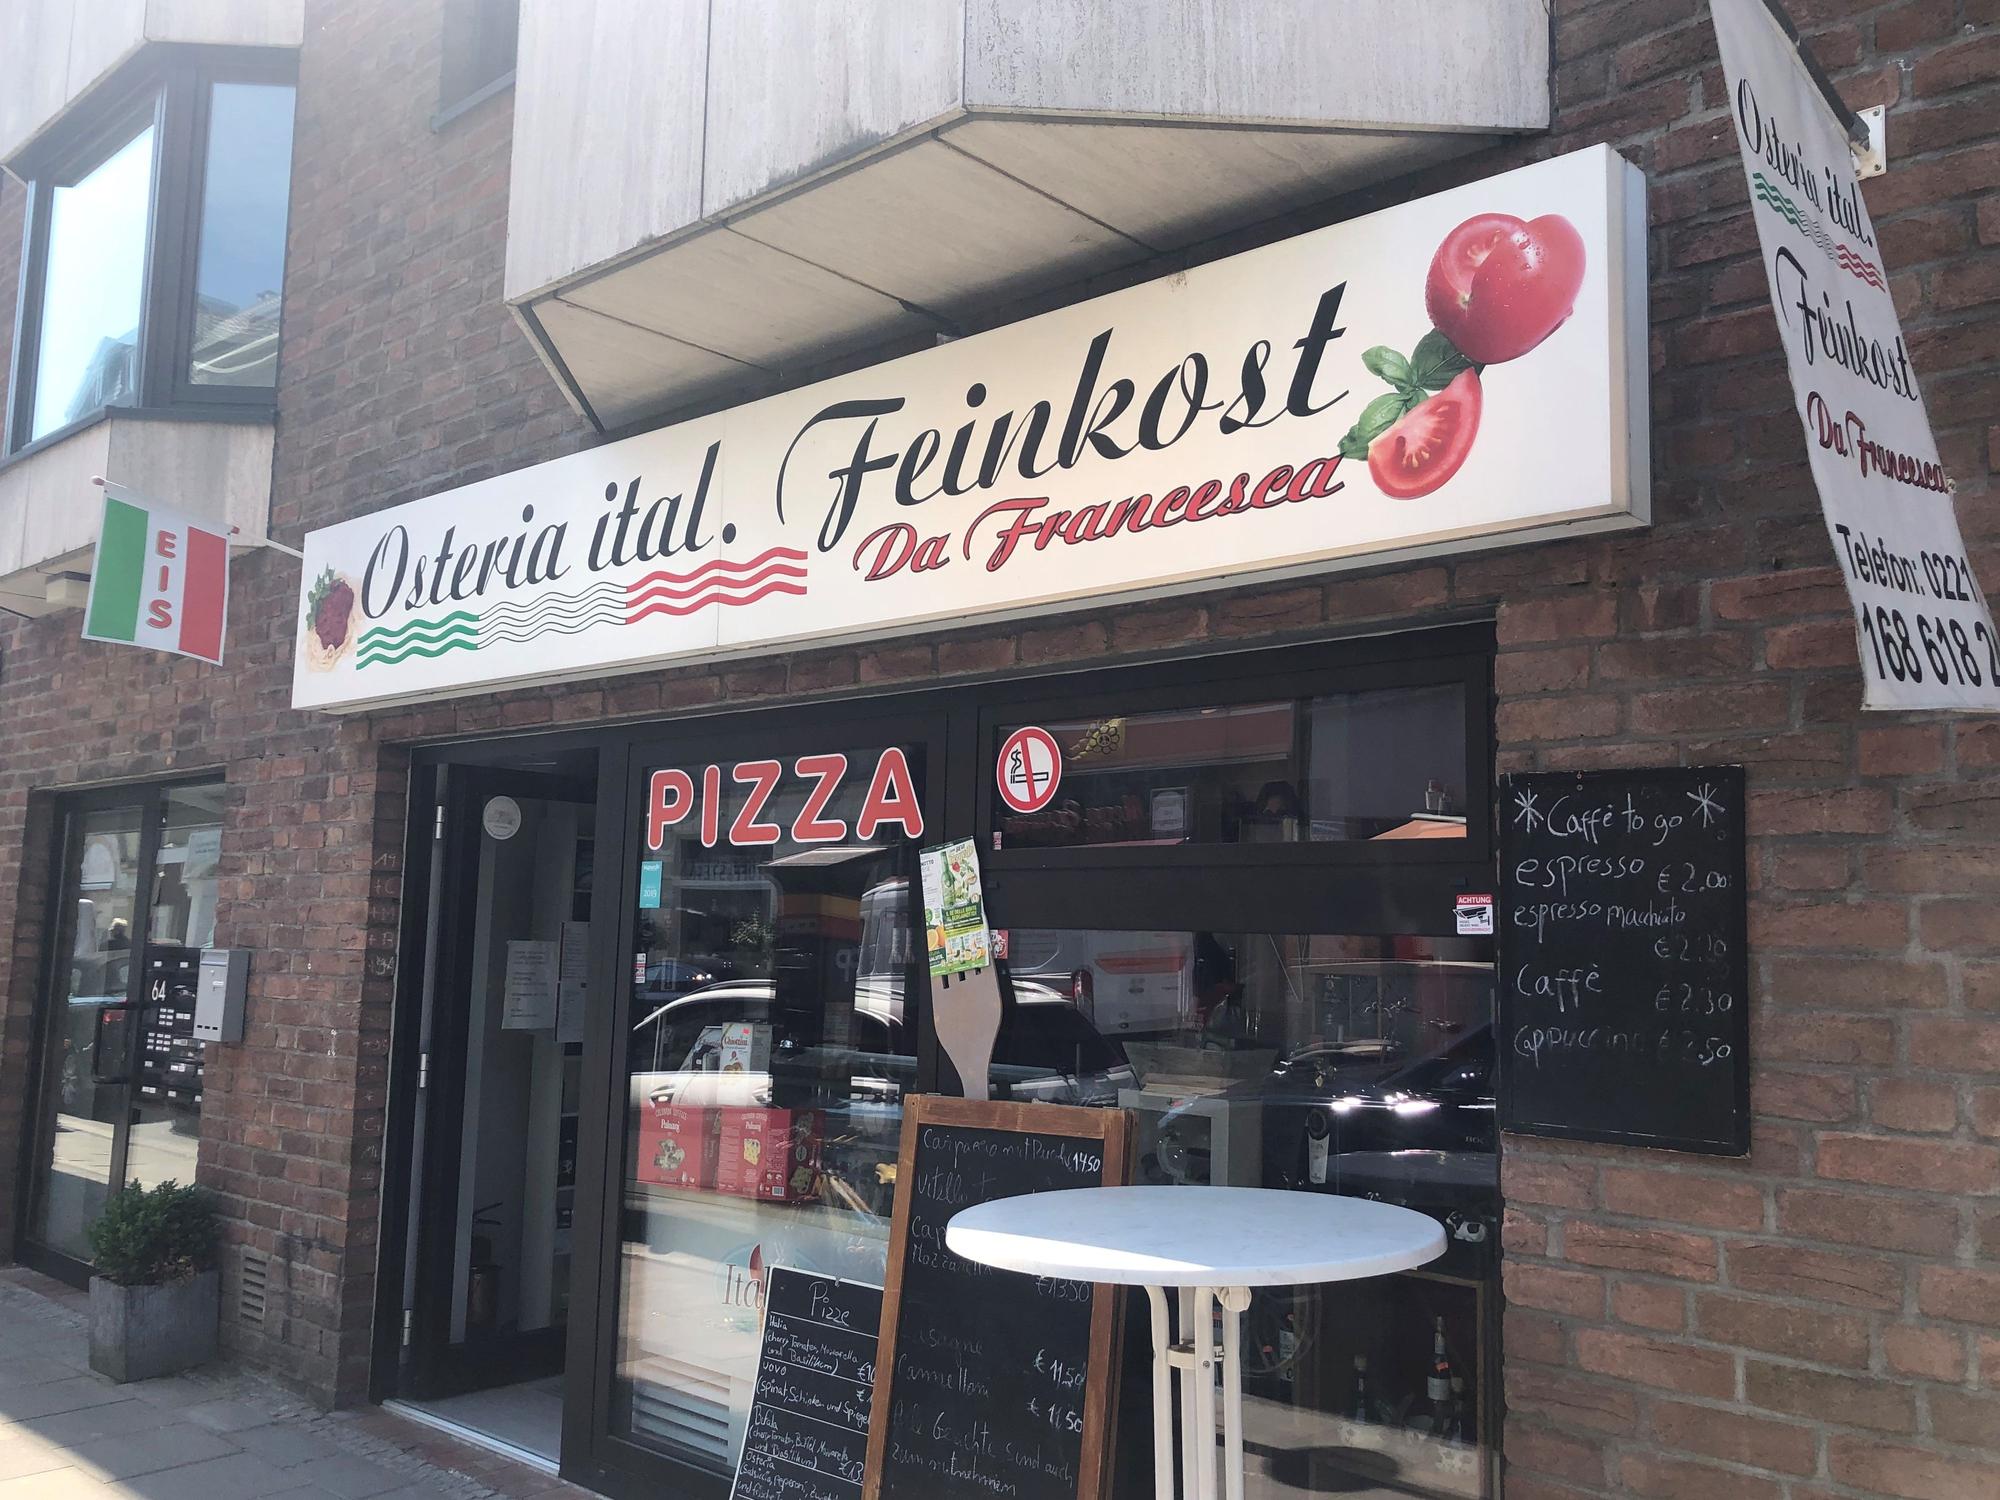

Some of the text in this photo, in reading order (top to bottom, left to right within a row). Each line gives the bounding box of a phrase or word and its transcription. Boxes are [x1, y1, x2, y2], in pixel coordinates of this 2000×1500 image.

[1737, 78, 1823, 214] Osteria
[1775, 246, 1917, 401] Feinkost
[361, 280, 1349, 619] Osteria ital. Feinkost
[1807, 391, 1949, 494] Da Francesca
[852, 452, 1349, 582] Da Francesca
[145, 529, 177, 629] EIS
[1835, 523, 1978, 602] Telefon: 0221
[1863, 602, 1922, 683] 168
[1917, 613, 1981, 687] 618
[647, 747, 924, 850] PIZZA
[1621, 793, 1644, 833] to
[1653, 814, 1683, 845] go
[1458, 896, 1491, 904] ACHTUNG
[1515, 855, 1645, 896] espresso
[1514, 900, 1601, 943] espresso
[151, 979, 166, 1001] 64
[809, 1281, 850, 1327] Pizze
